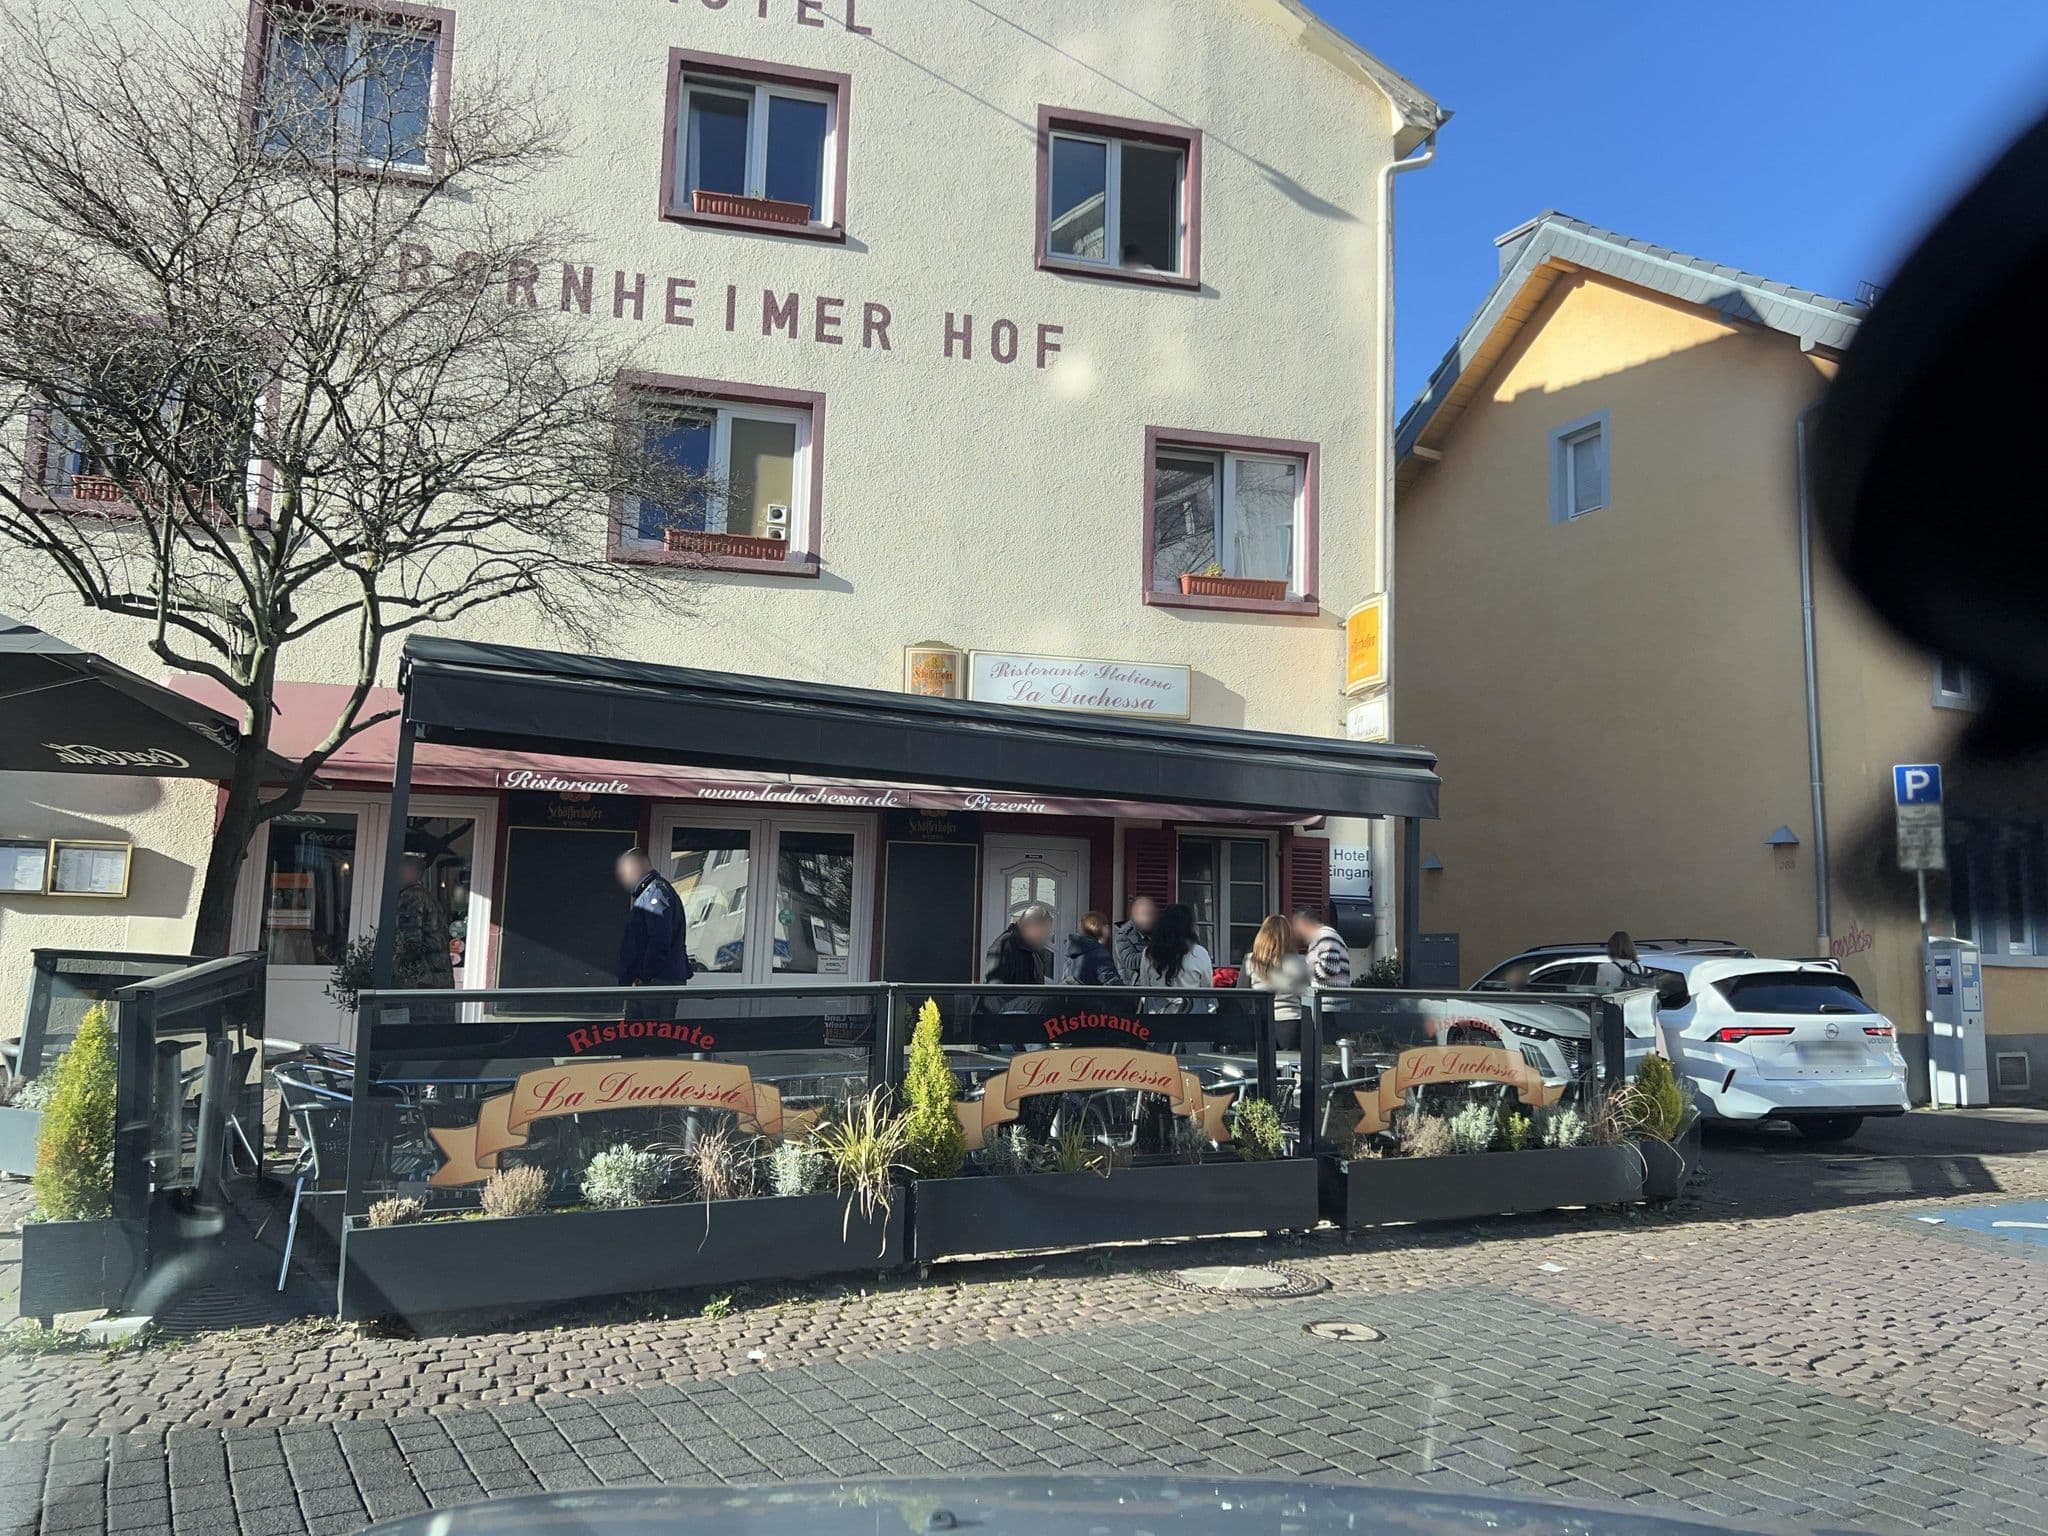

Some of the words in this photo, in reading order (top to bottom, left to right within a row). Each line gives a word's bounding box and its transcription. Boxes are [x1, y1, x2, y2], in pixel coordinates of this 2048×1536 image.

[400, 243, 892, 351] BORNHEIMER
[943, 311, 1064, 369] HOF
[990, 661, 1090, 679] Ristorante
[1094, 664, 1176, 692] Italiano
[1007, 680, 1046, 702] La
[1051, 682, 1159, 710] Duchessa
[504, 770, 630, 794] Ristorante
[698, 783, 898, 808] www.laduchessa.de
[1905, 769, 1931, 801] P
[963, 792, 1047, 814] Pizzeria
[1334, 849, 1369, 862] Hotel
[567, 1019, 717, 1054] Ristorante
[1043, 1010, 1150, 1040] Ristorante
[1016, 1057, 1062, 1090] La
[1069, 1055, 1173, 1088] Duchessa
[1405, 1053, 1437, 1080] La
[1439, 1051, 1521, 1078] Duchessa
[523, 1076, 588, 1116] La
[594, 1070, 745, 1104] Duchessa
